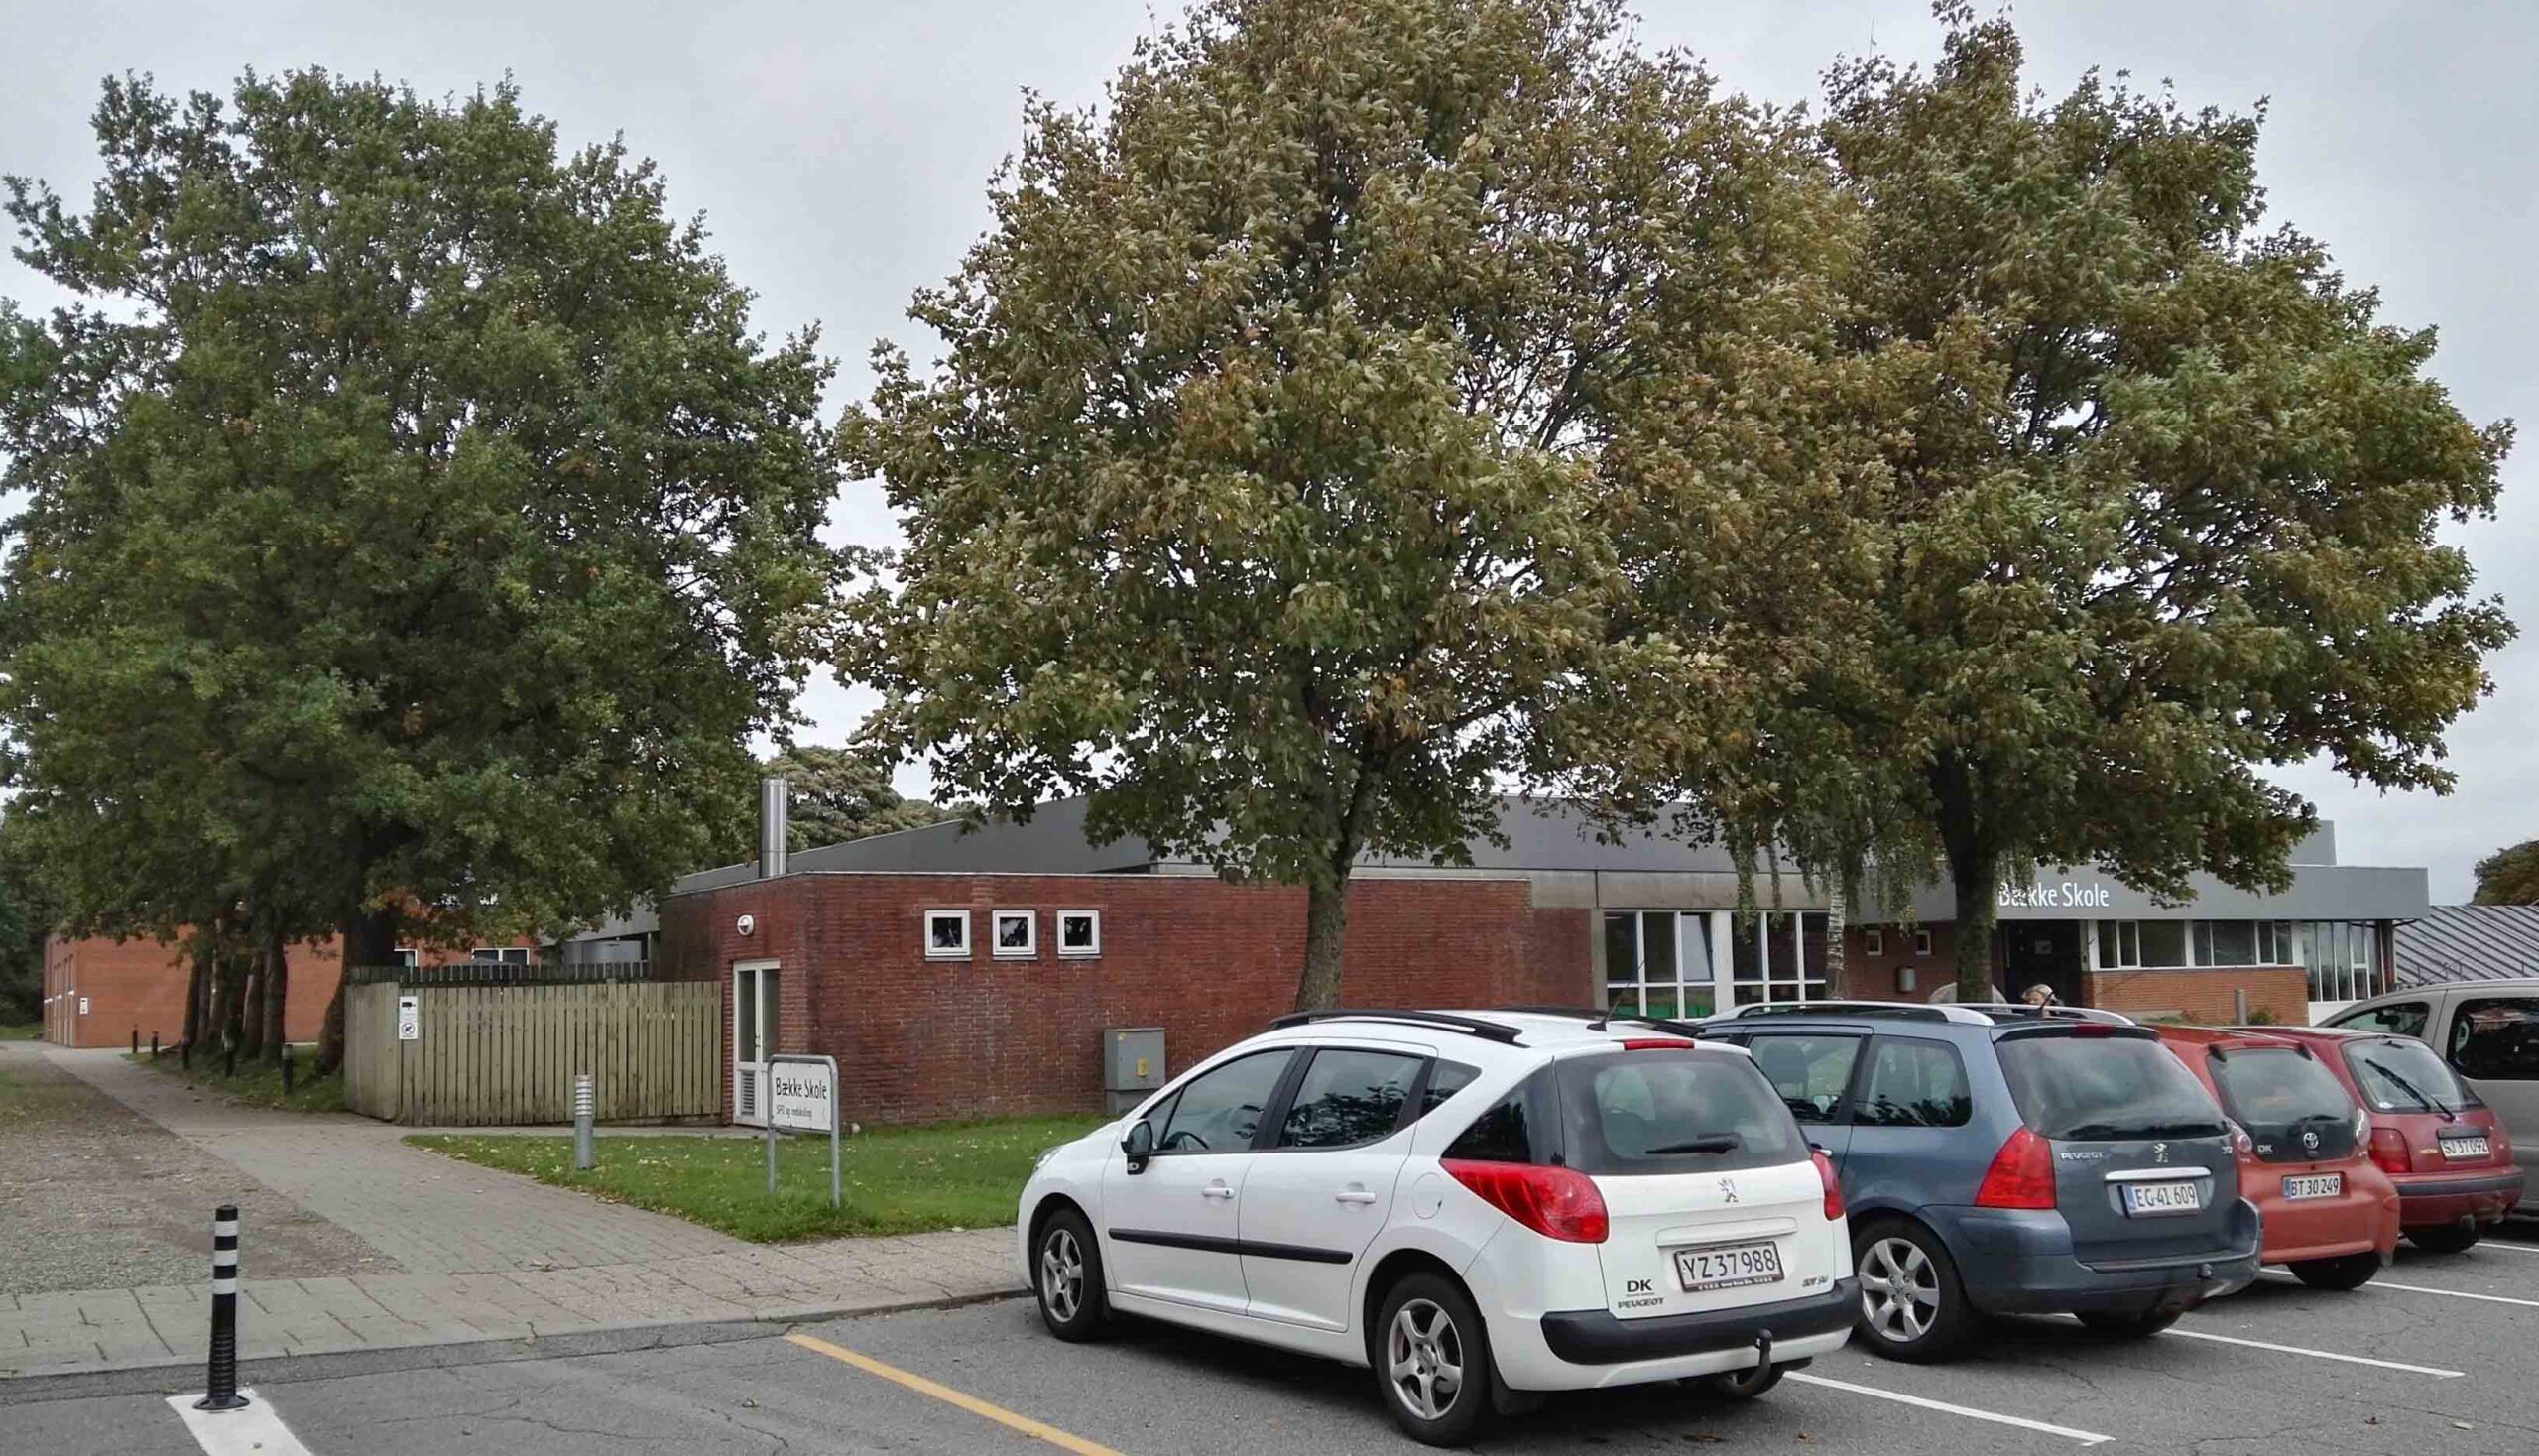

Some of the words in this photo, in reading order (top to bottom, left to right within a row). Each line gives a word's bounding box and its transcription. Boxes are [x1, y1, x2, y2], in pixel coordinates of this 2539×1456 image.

[1998, 882, 2058, 907] Bække
[2062, 882, 2110, 907] Skole
[775, 1077, 803, 1097] Bække
[804, 1079, 827, 1100] Skole
[2257, 1144, 2272, 1153] DK
[2061, 1151, 2104, 1160] PEUGEOT
[1627, 1279, 1653, 1292] DK
[1618, 1297, 1665, 1309] PEUGEOT
